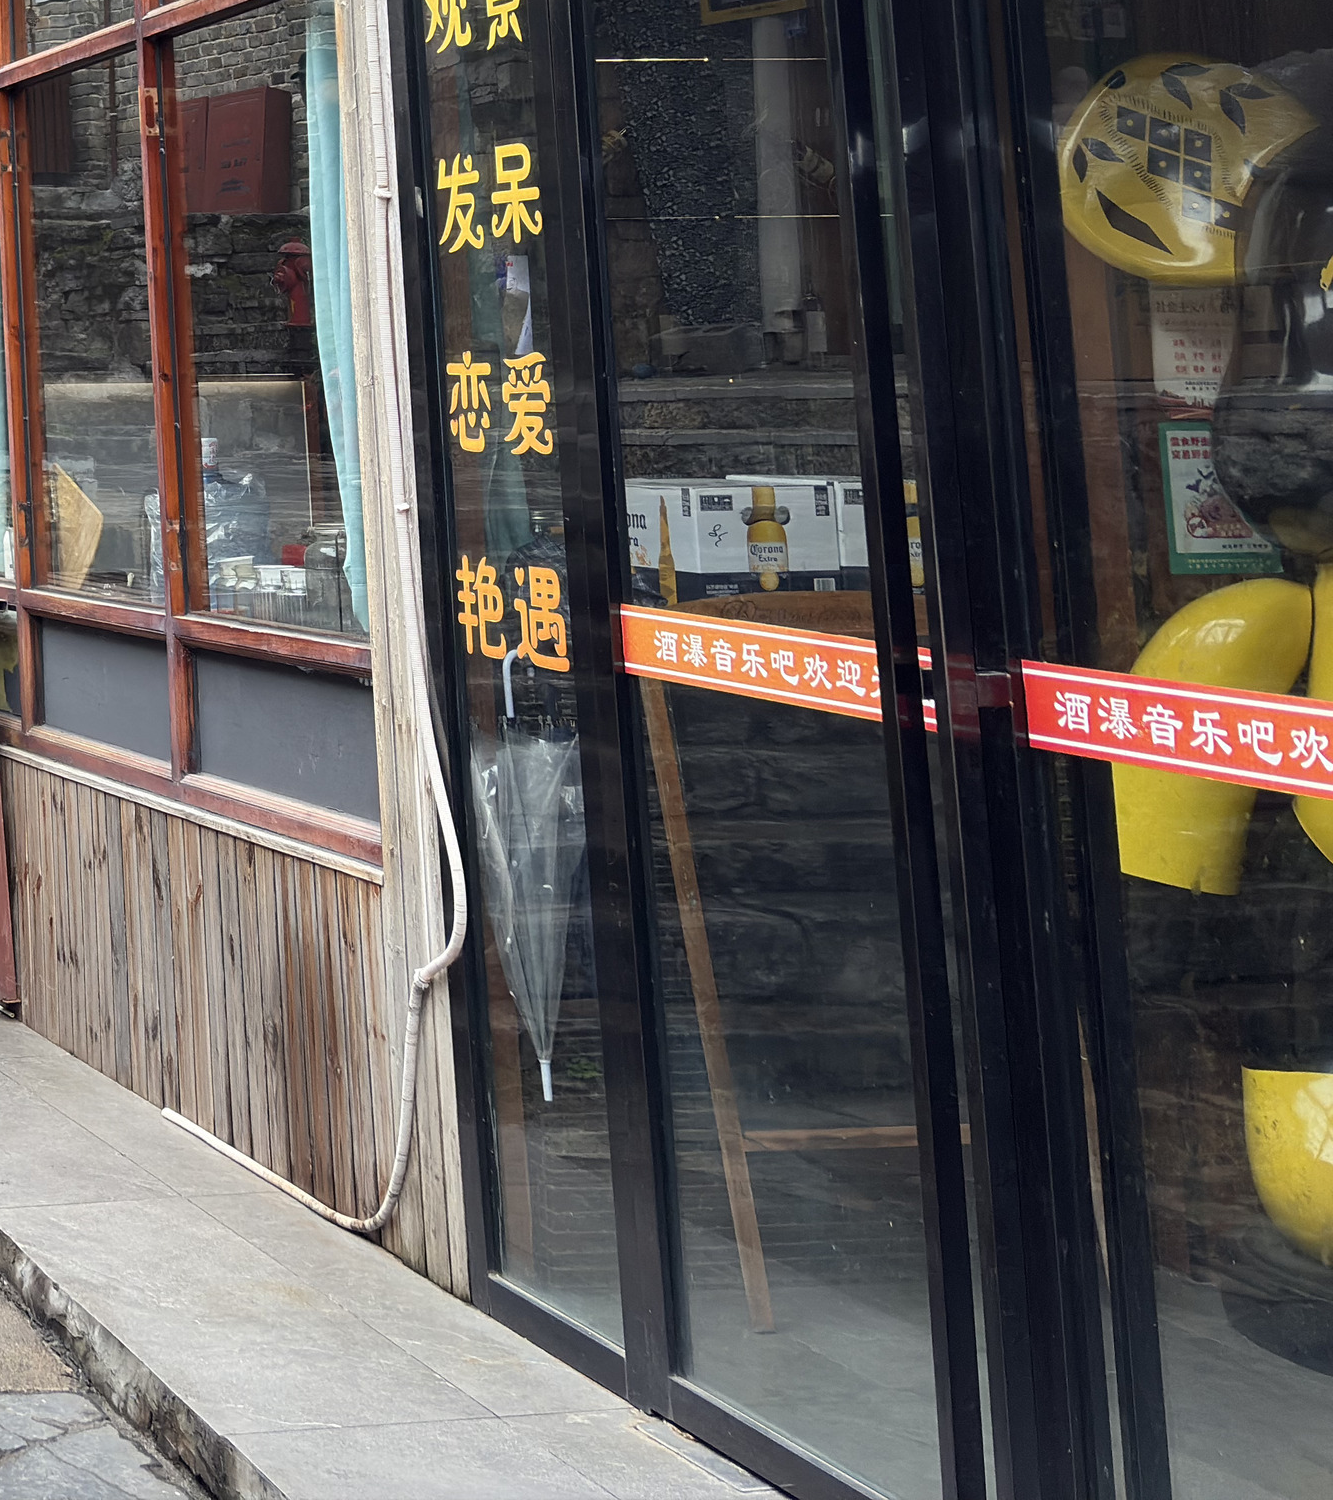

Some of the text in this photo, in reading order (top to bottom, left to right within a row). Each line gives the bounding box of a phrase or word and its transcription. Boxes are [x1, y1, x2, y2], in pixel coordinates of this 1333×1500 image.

[437, 142, 543, 253] 发呆
[446, 350, 553, 455] 恋爱
[749, 543, 784, 557] Corona
[758, 554, 778, 563] Extra
[455, 554, 571, 672] 艳遇
[653, 630, 881, 699] 酒瀑音乐吧欢迎
[1054, 690, 1333, 772] 酒瀑音乐吧欢
